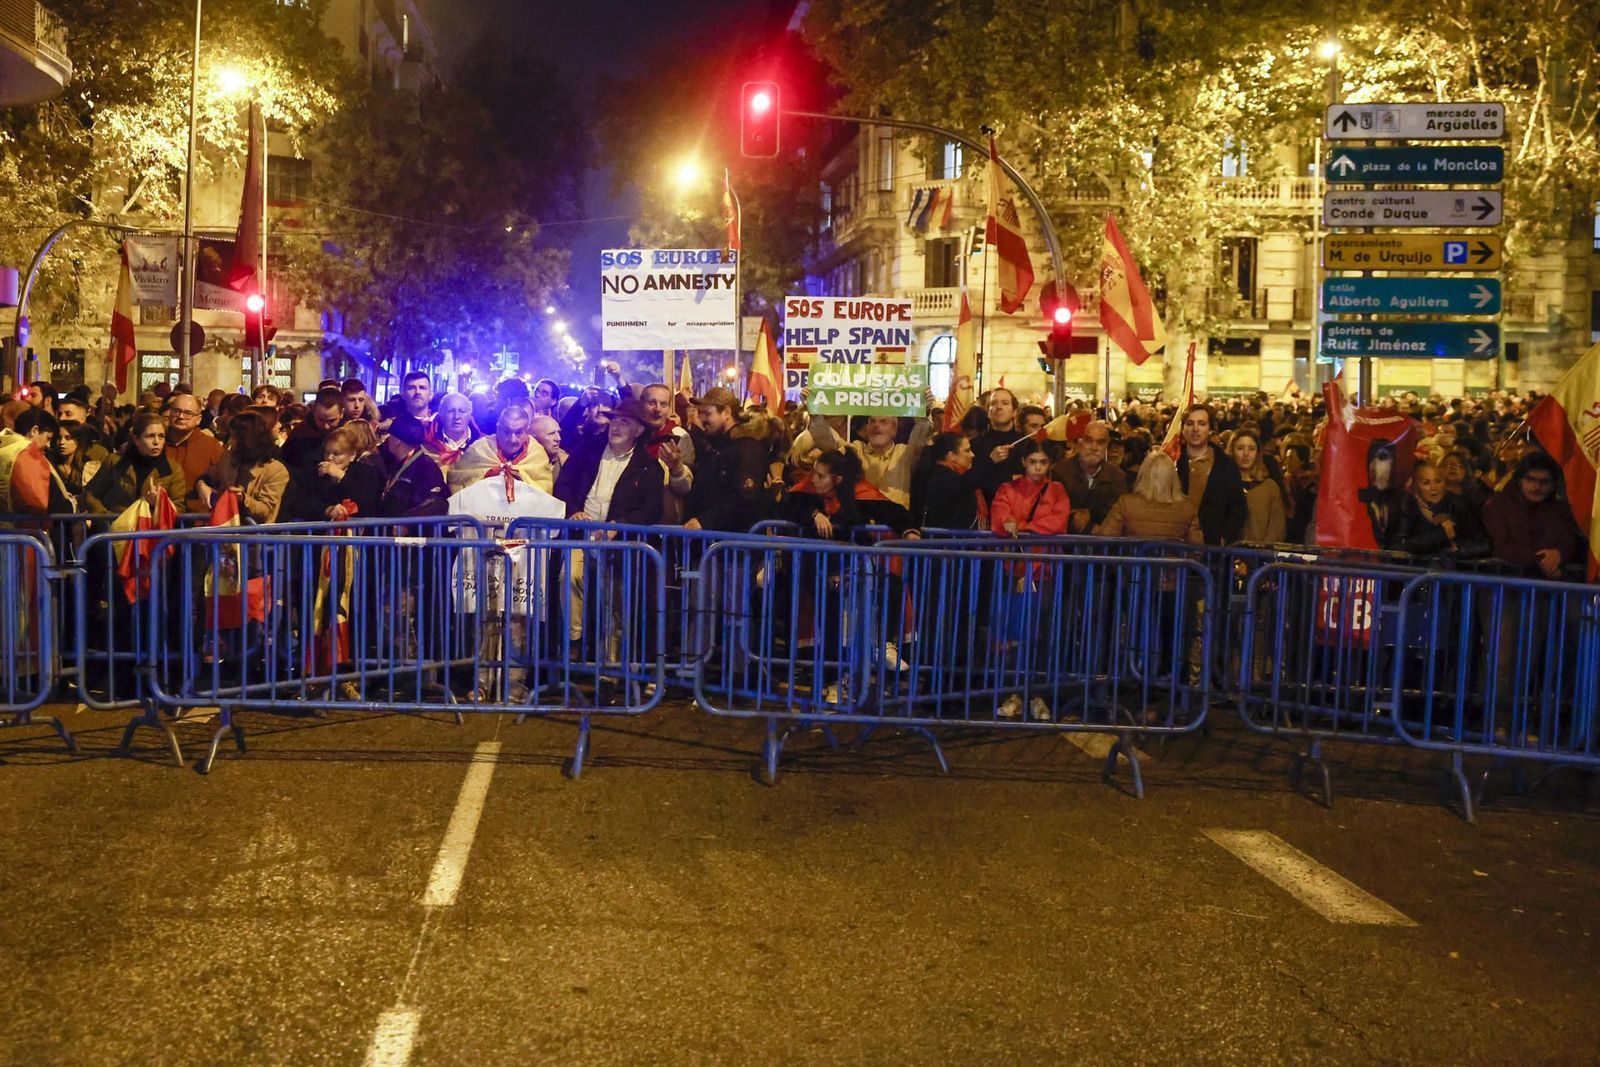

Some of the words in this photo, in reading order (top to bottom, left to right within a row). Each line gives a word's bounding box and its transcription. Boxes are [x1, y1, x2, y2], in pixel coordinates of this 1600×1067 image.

[1426, 109, 1476, 118] mercado
[1483, 108, 1498, 118] de
[1425, 119, 1498, 132] Argüelles
[1362, 163, 1391, 173] plaza
[1397, 161, 1410, 171] de
[1416, 162, 1428, 171] la
[1433, 158, 1498, 171] Moncloa
[1331, 197, 1366, 205] centro
[1371, 196, 1415, 205] cultural
[1330, 208, 1375, 220] Conde
[1383, 208, 1429, 222] Duque
[1330, 240, 1403, 249] aparcamiento
[601, 251, 643, 267] SOS
[1354, 251, 1371, 262] de
[1379, 250, 1433, 266] Urquijo
[1447, 243, 1464, 262] P
[602, 275, 639, 294] NO
[643, 274, 736, 290] AMNESTY
[1329, 284, 1356, 293] calle
[1329, 295, 1381, 307] Alberto
[1389, 296, 1449, 309] Aguilera
[787, 299, 824, 319] SOS
[834, 301, 911, 321] EUROPE
[785, 328, 840, 346] HELP
[848, 327, 910, 346] SPAIN
[1327, 326, 1373, 337] glorieta
[1378, 326, 1394, 336] de
[1327, 337, 1360, 350] Ruiz
[1367, 337, 1427, 351] Jiménez
[820, 349, 872, 364] SAVE
[813, 391, 829, 405] A
[835, 388, 921, 407] PRISIÓN
